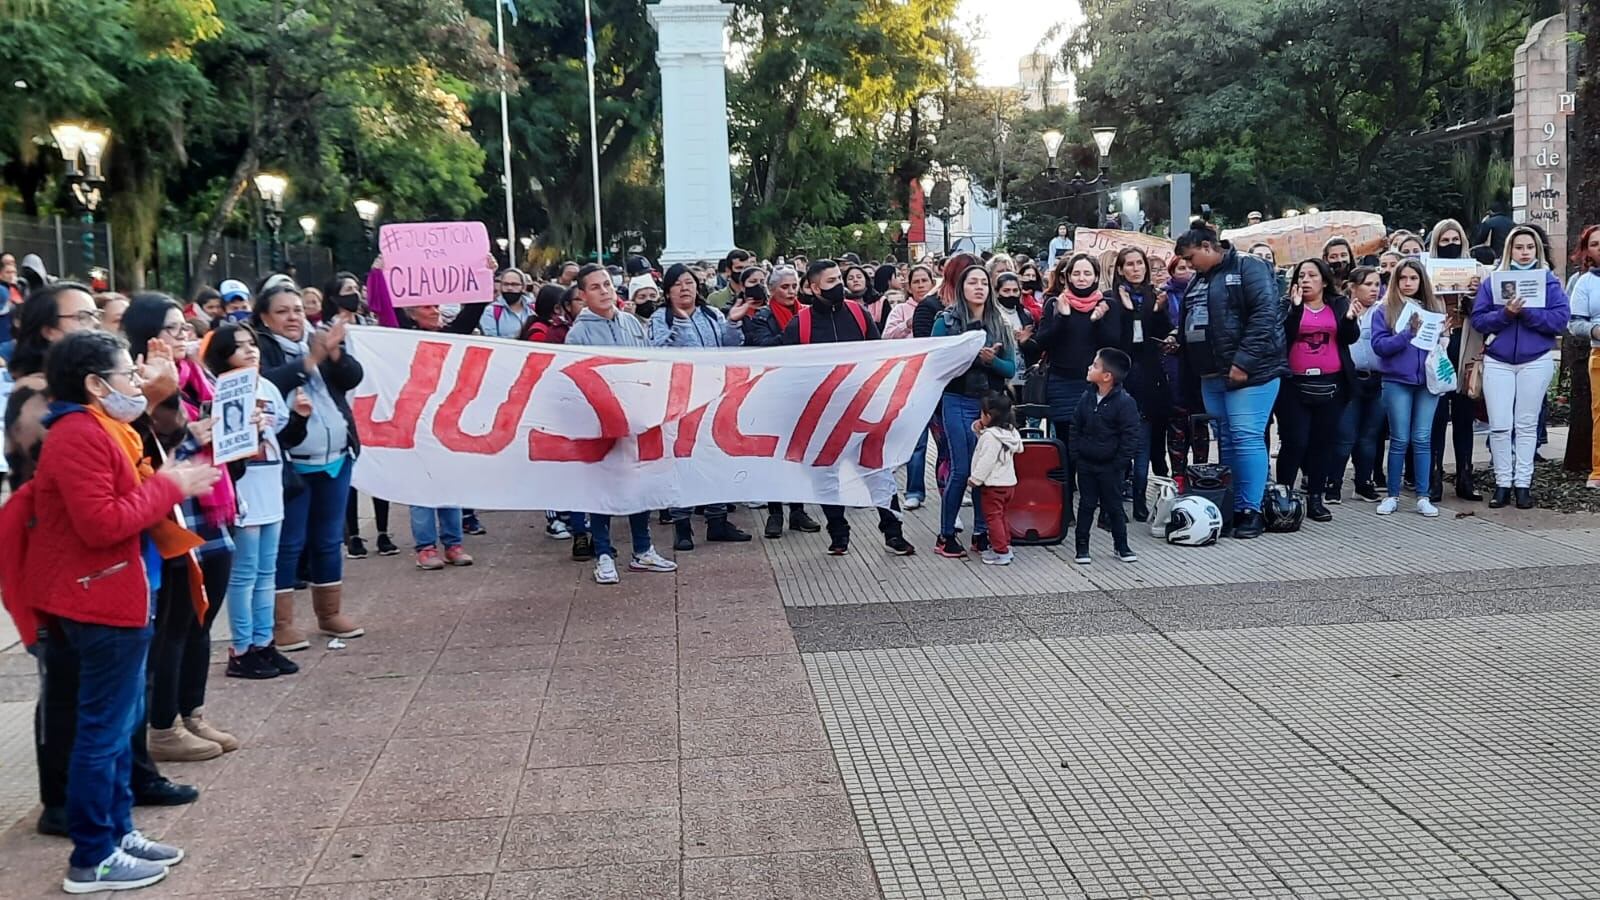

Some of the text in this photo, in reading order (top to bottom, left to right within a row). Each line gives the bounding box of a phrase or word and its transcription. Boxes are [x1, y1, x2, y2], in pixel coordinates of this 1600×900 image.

[1543, 121, 1555, 141] 9
[1536, 147, 1560, 166] de
[390, 264, 479, 298] CLAUDIA
